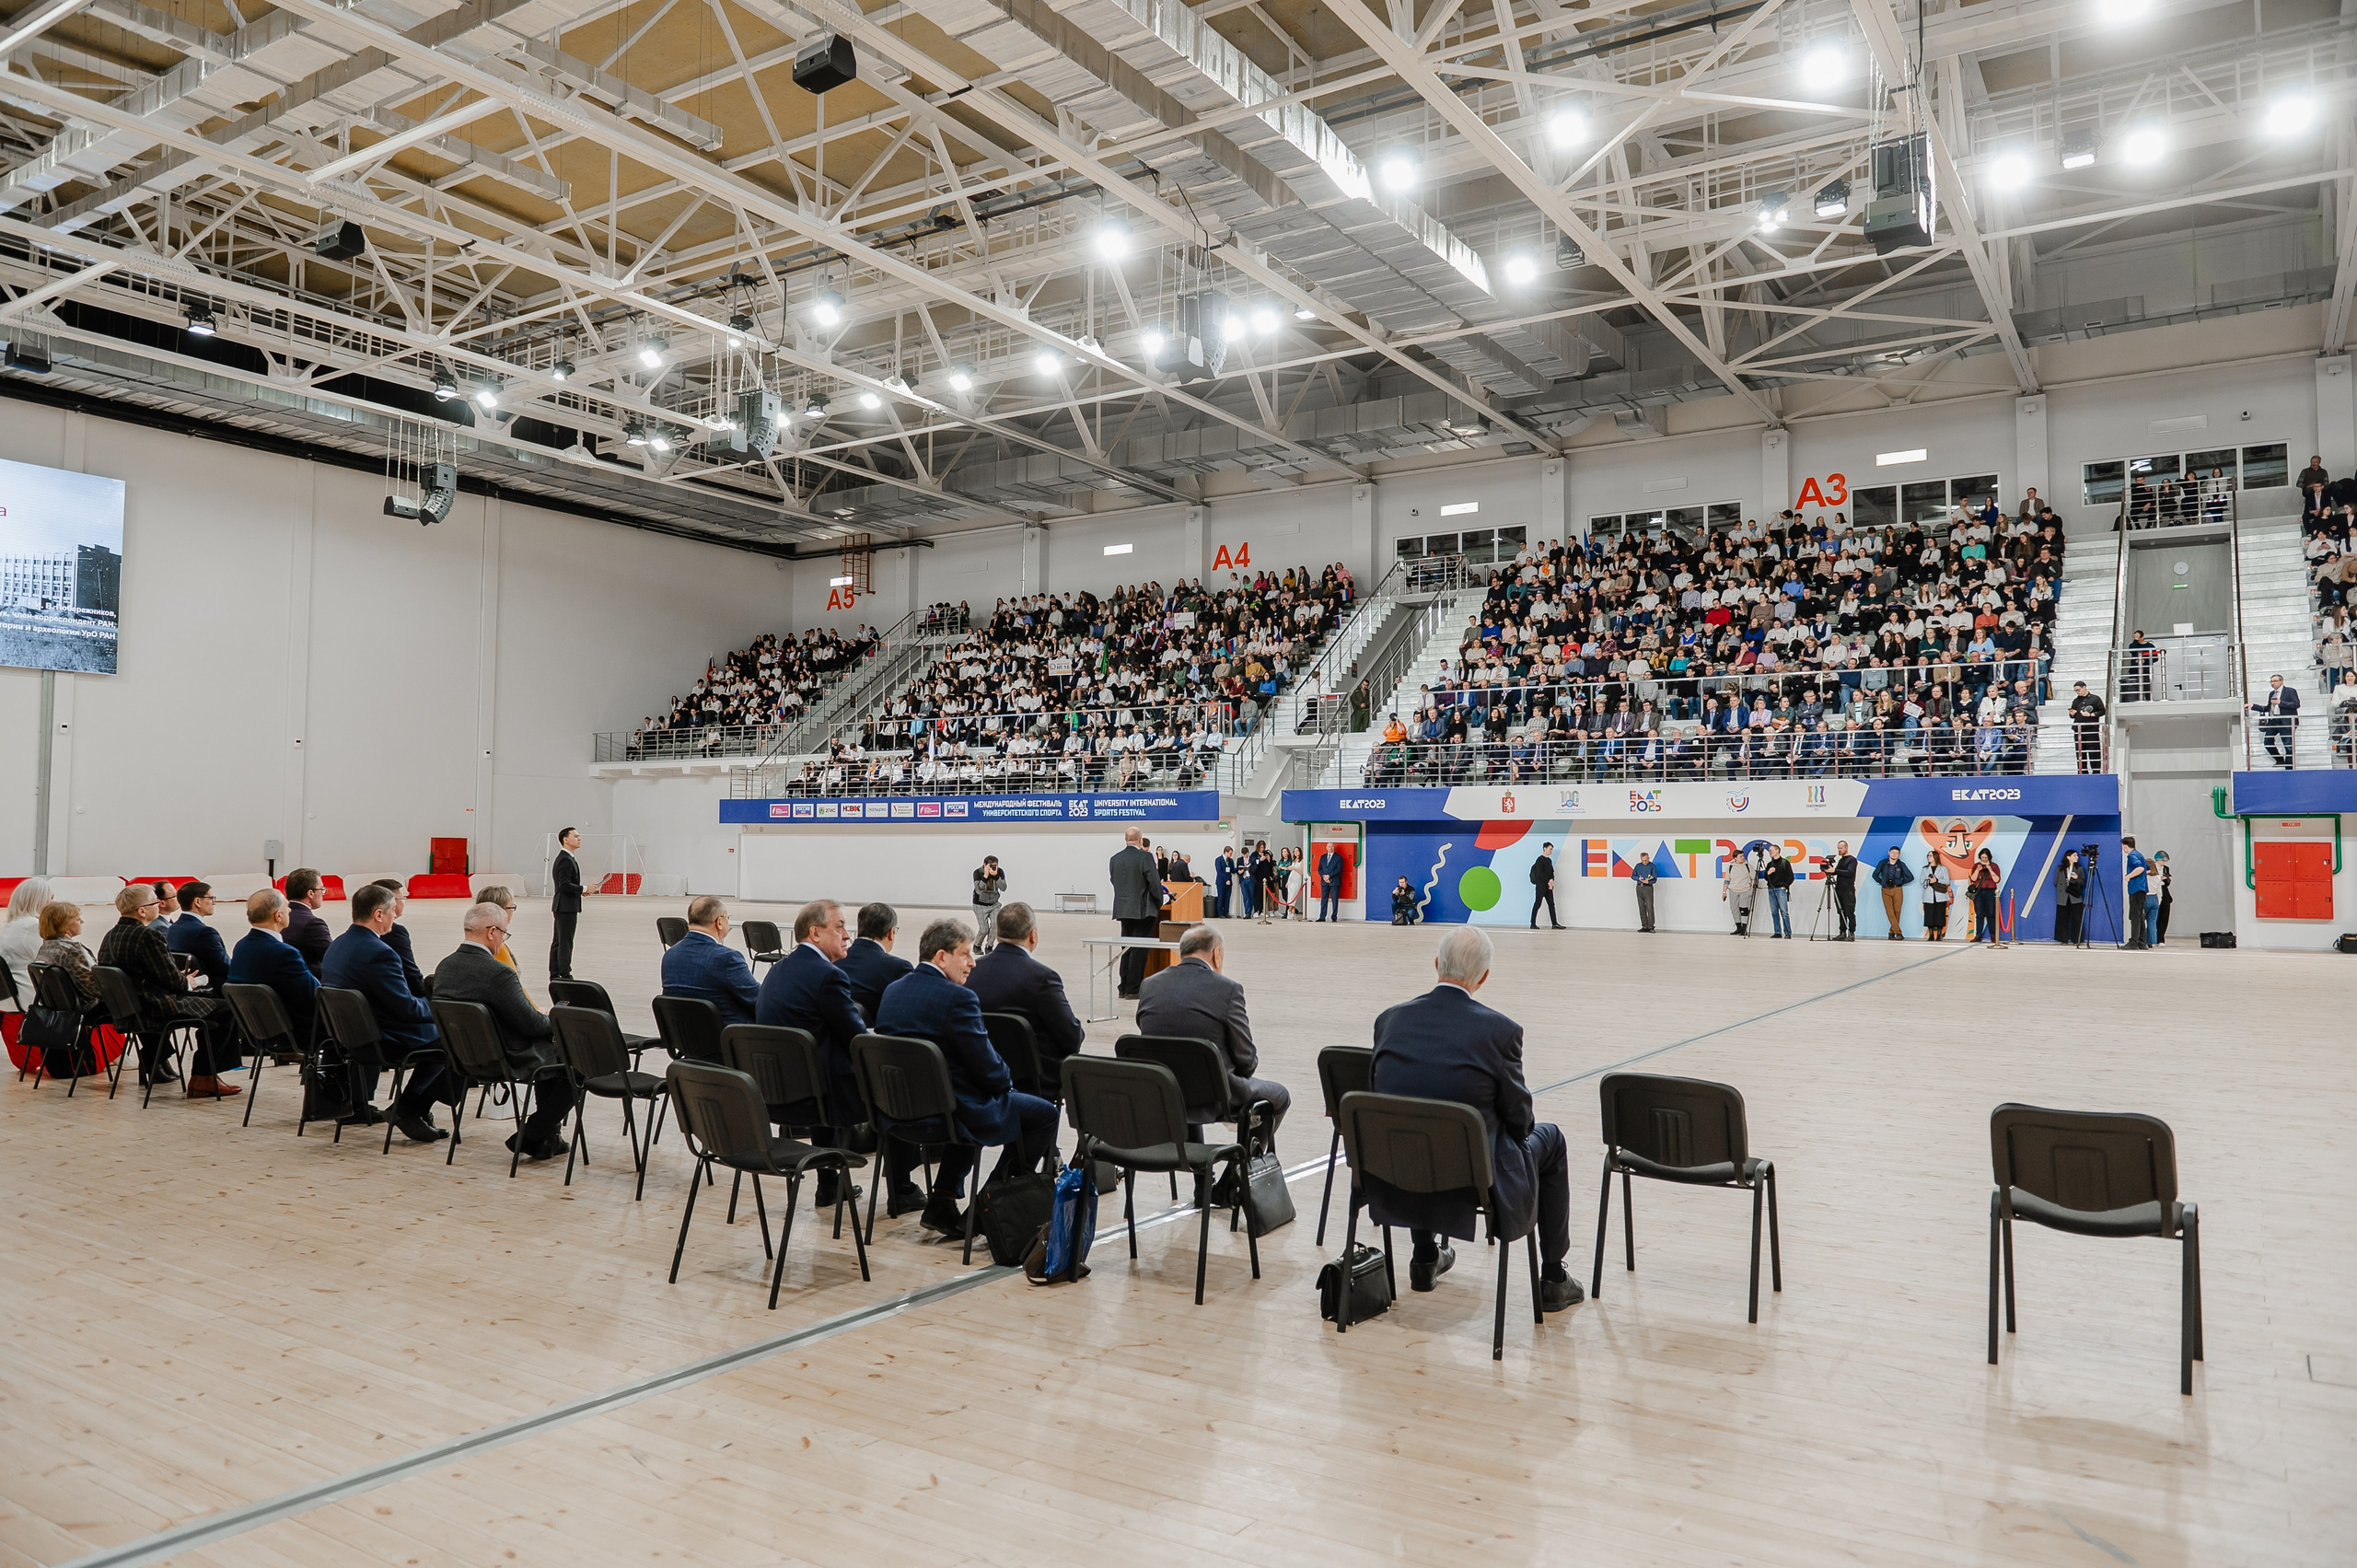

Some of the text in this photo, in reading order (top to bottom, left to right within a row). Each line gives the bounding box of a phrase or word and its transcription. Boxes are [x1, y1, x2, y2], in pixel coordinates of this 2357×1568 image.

[1794, 472, 1848, 510] A3
[1212, 541, 1250, 571] A4
[827, 585, 855, 610] A5
[12, 612, 96, 626] член-корреспондент
[98, 620, 116, 629] РАН,
[33, 626, 80, 636] археологии
[81, 629, 98, 638] УрО
[99, 632, 116, 640] РАН
[1630, 789, 1661, 800] EKAT
[1952, 788, 2021, 801] EKAT2023
[974, 798, 1062, 808] МЕЖДУНАРОДНЫЙ ФЕСТИВАЛЬ
[1068, 799, 1088, 808] EKAT
[1094, 798, 1178, 807] UNIVERSITY INTERNATIONAL
[1340, 799, 1386, 809] EKAT2023
[982, 808, 1039, 818] УНИВЕРСИТЕТСКОГО
[1068, 807, 1088, 818] 2023
[1094, 808, 1146, 817] SPORTS FESTIVAL
